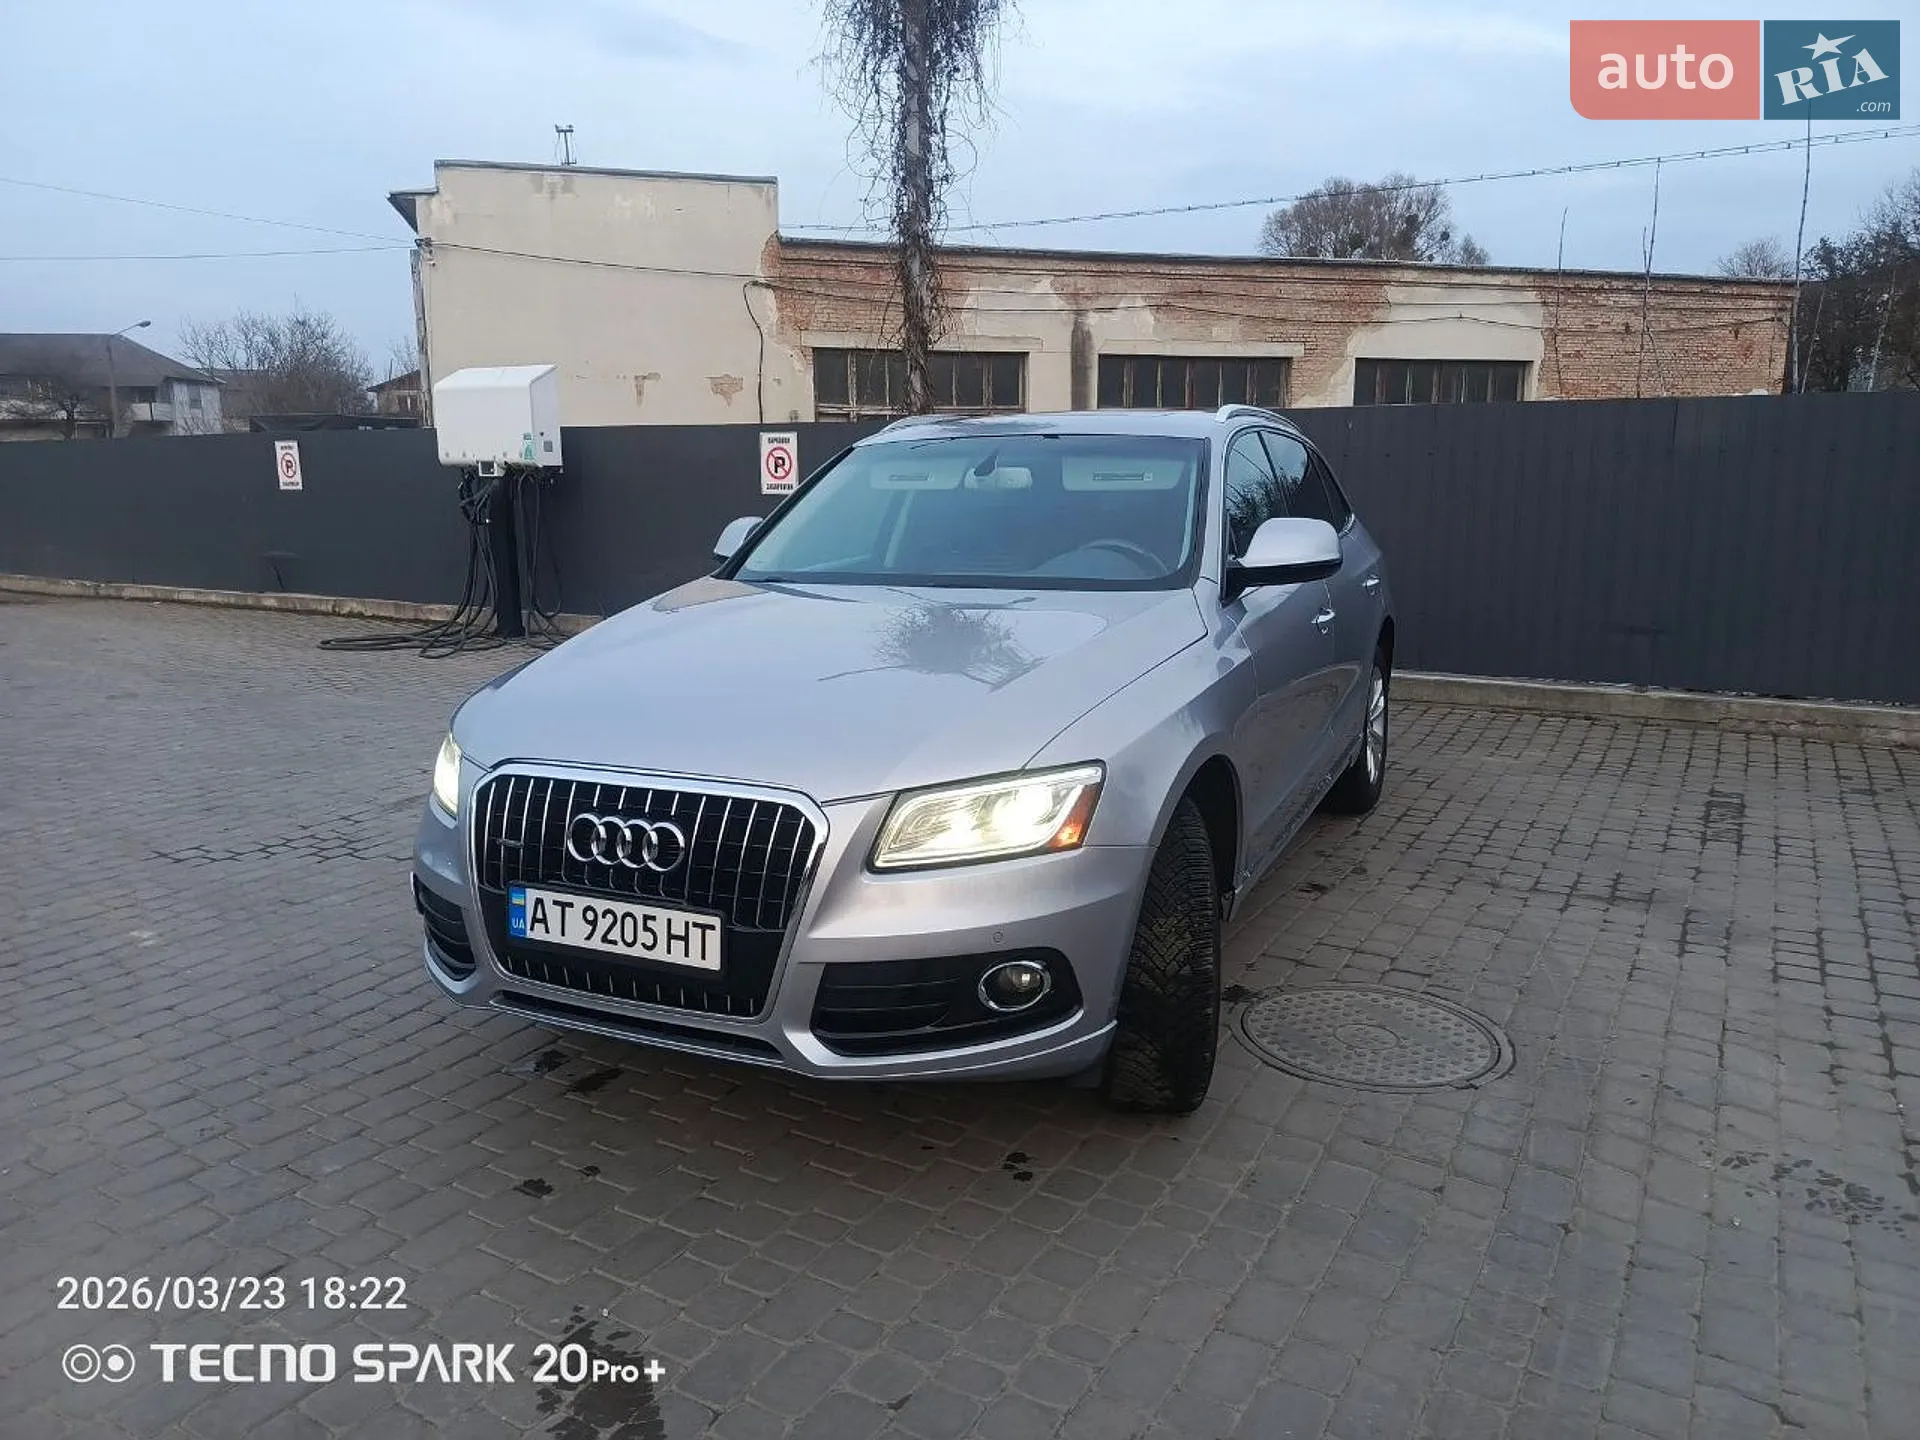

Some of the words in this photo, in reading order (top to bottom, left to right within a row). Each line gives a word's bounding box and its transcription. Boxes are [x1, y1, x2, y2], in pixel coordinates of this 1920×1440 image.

[513, 919, 525, 929] UA
[529, 897, 574, 937] AT
[582, 904, 659, 952] 9205
[665, 917, 717, 961] HT
